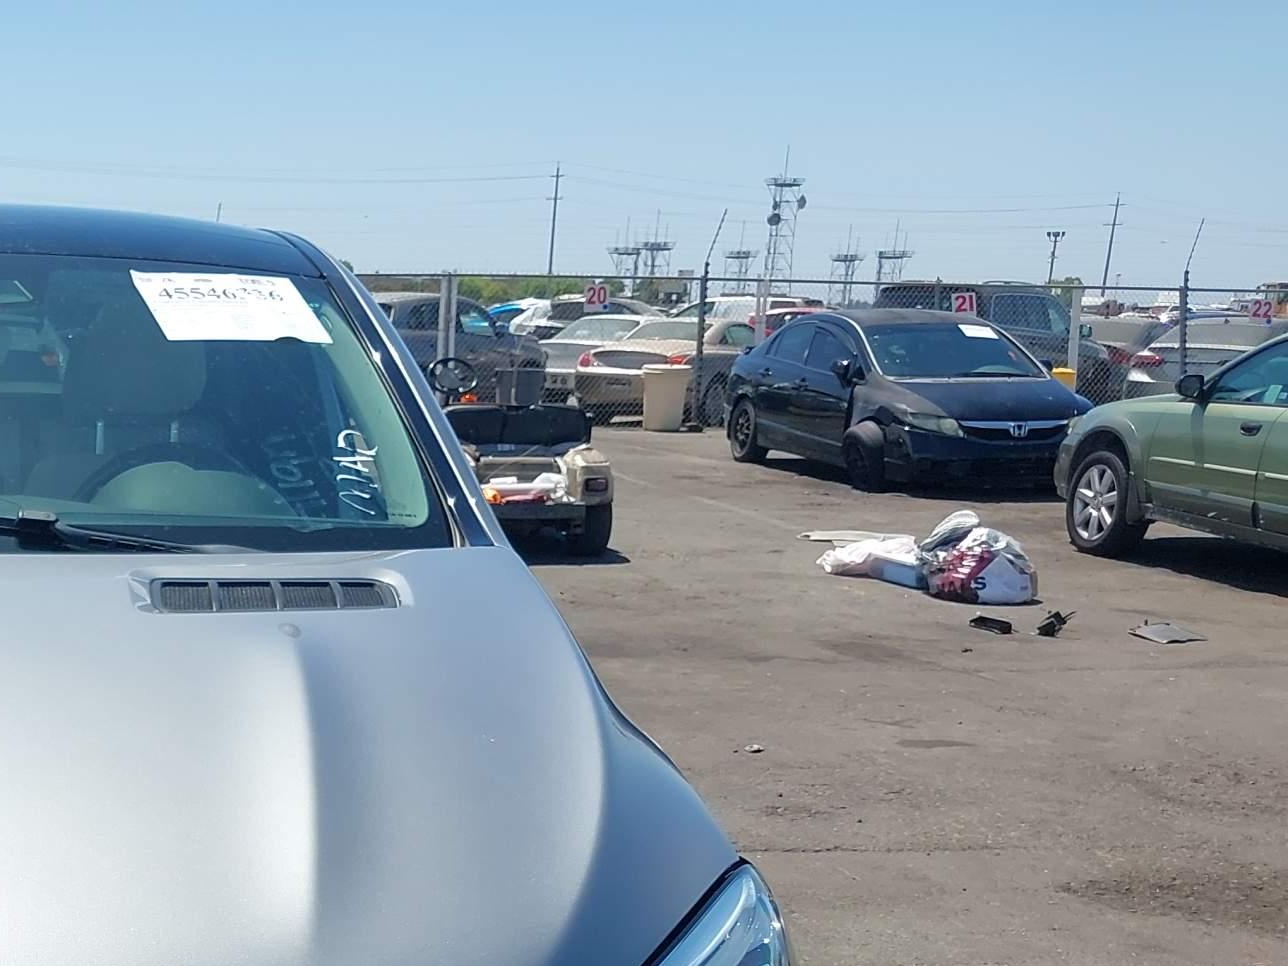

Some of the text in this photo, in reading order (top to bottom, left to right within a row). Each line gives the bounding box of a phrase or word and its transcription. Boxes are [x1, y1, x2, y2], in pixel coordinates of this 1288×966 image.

[587, 286, 607, 305] 20
[954, 294, 974, 313] 21
[1252, 300, 1272, 319] 22
